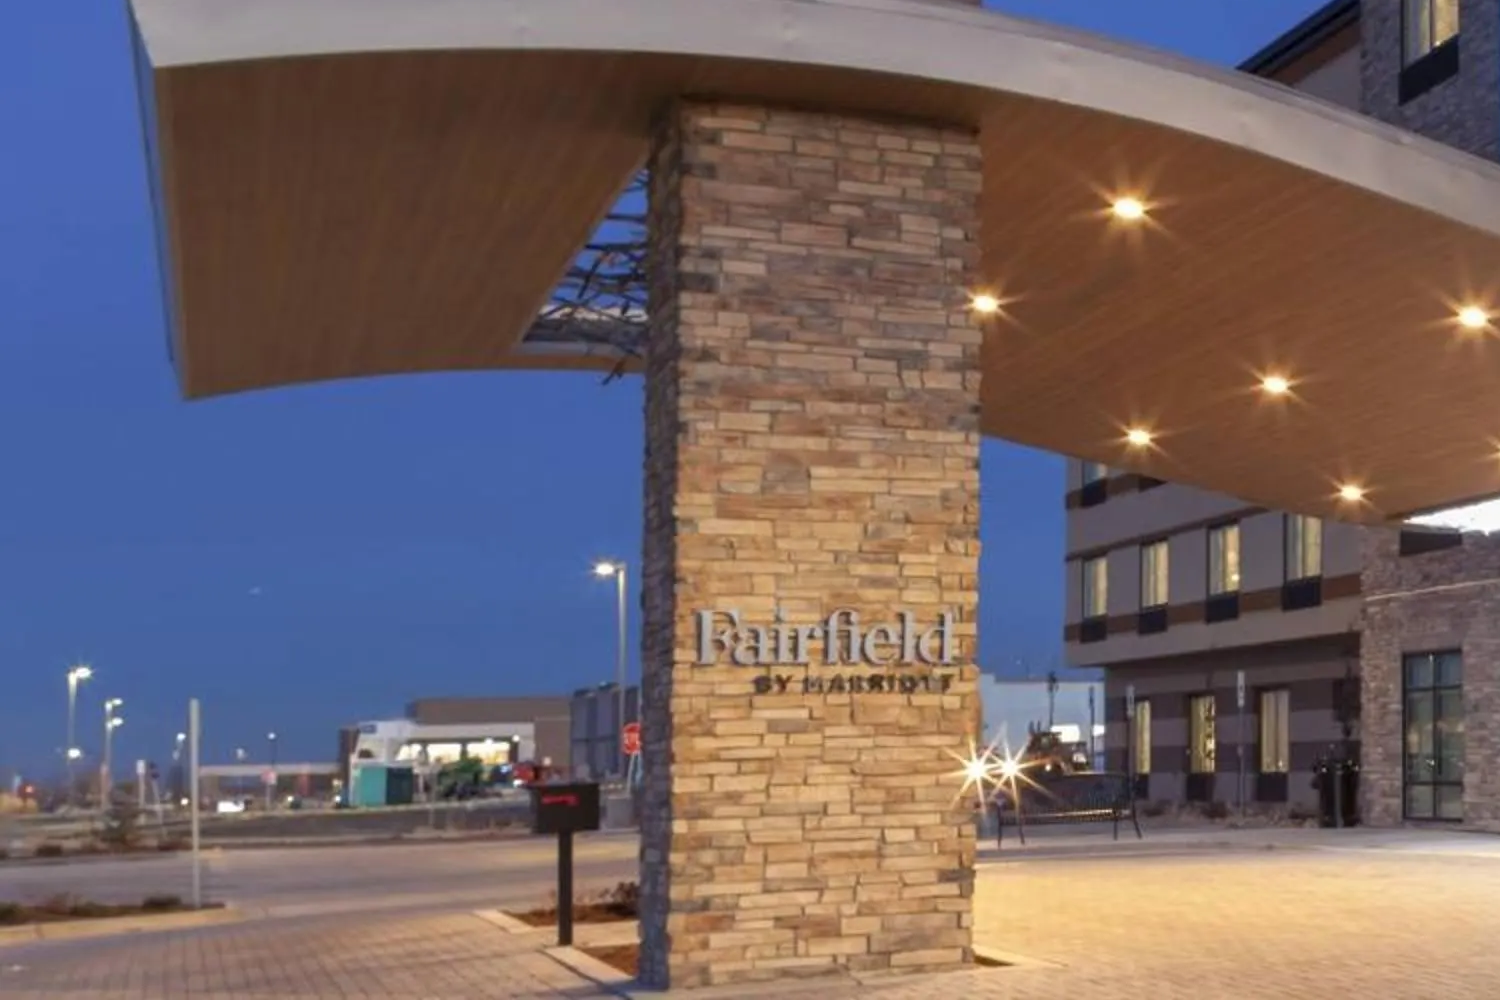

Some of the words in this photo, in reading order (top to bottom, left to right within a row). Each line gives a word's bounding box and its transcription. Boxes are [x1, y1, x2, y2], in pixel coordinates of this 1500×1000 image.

[693, 607, 960, 667] Fairfield
[754, 674, 793, 694] BY
[802, 673, 955, 695] MARRIOTT
